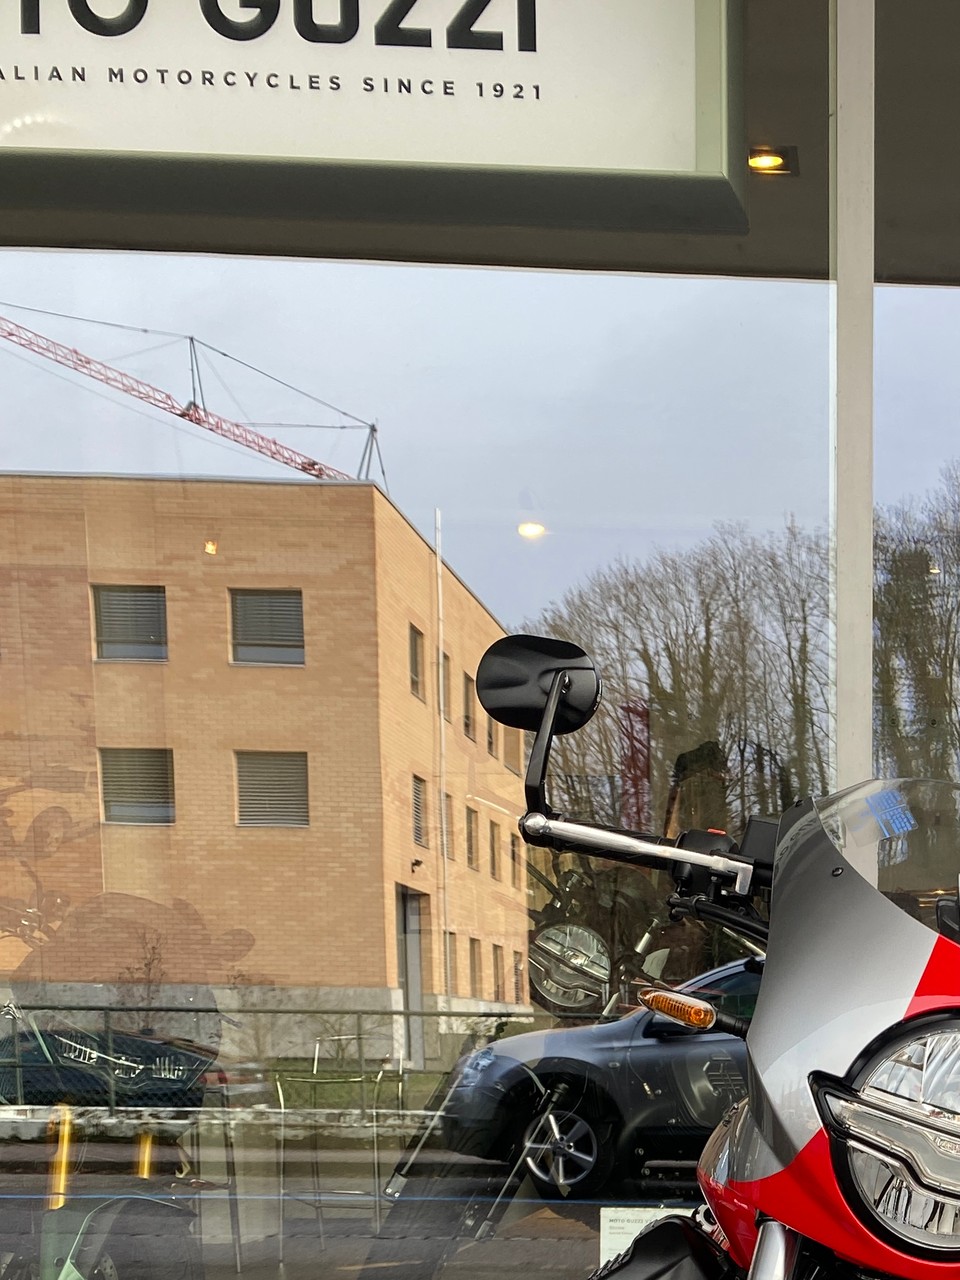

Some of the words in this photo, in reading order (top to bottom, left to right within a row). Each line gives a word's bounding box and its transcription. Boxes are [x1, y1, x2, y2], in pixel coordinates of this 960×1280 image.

[199, 0, 538, 52] GUZZI
[107, 67, 341, 91] MOTORCYCLES
[362, 76, 455, 96] SINCE
[475, 81, 541, 100] 1921
